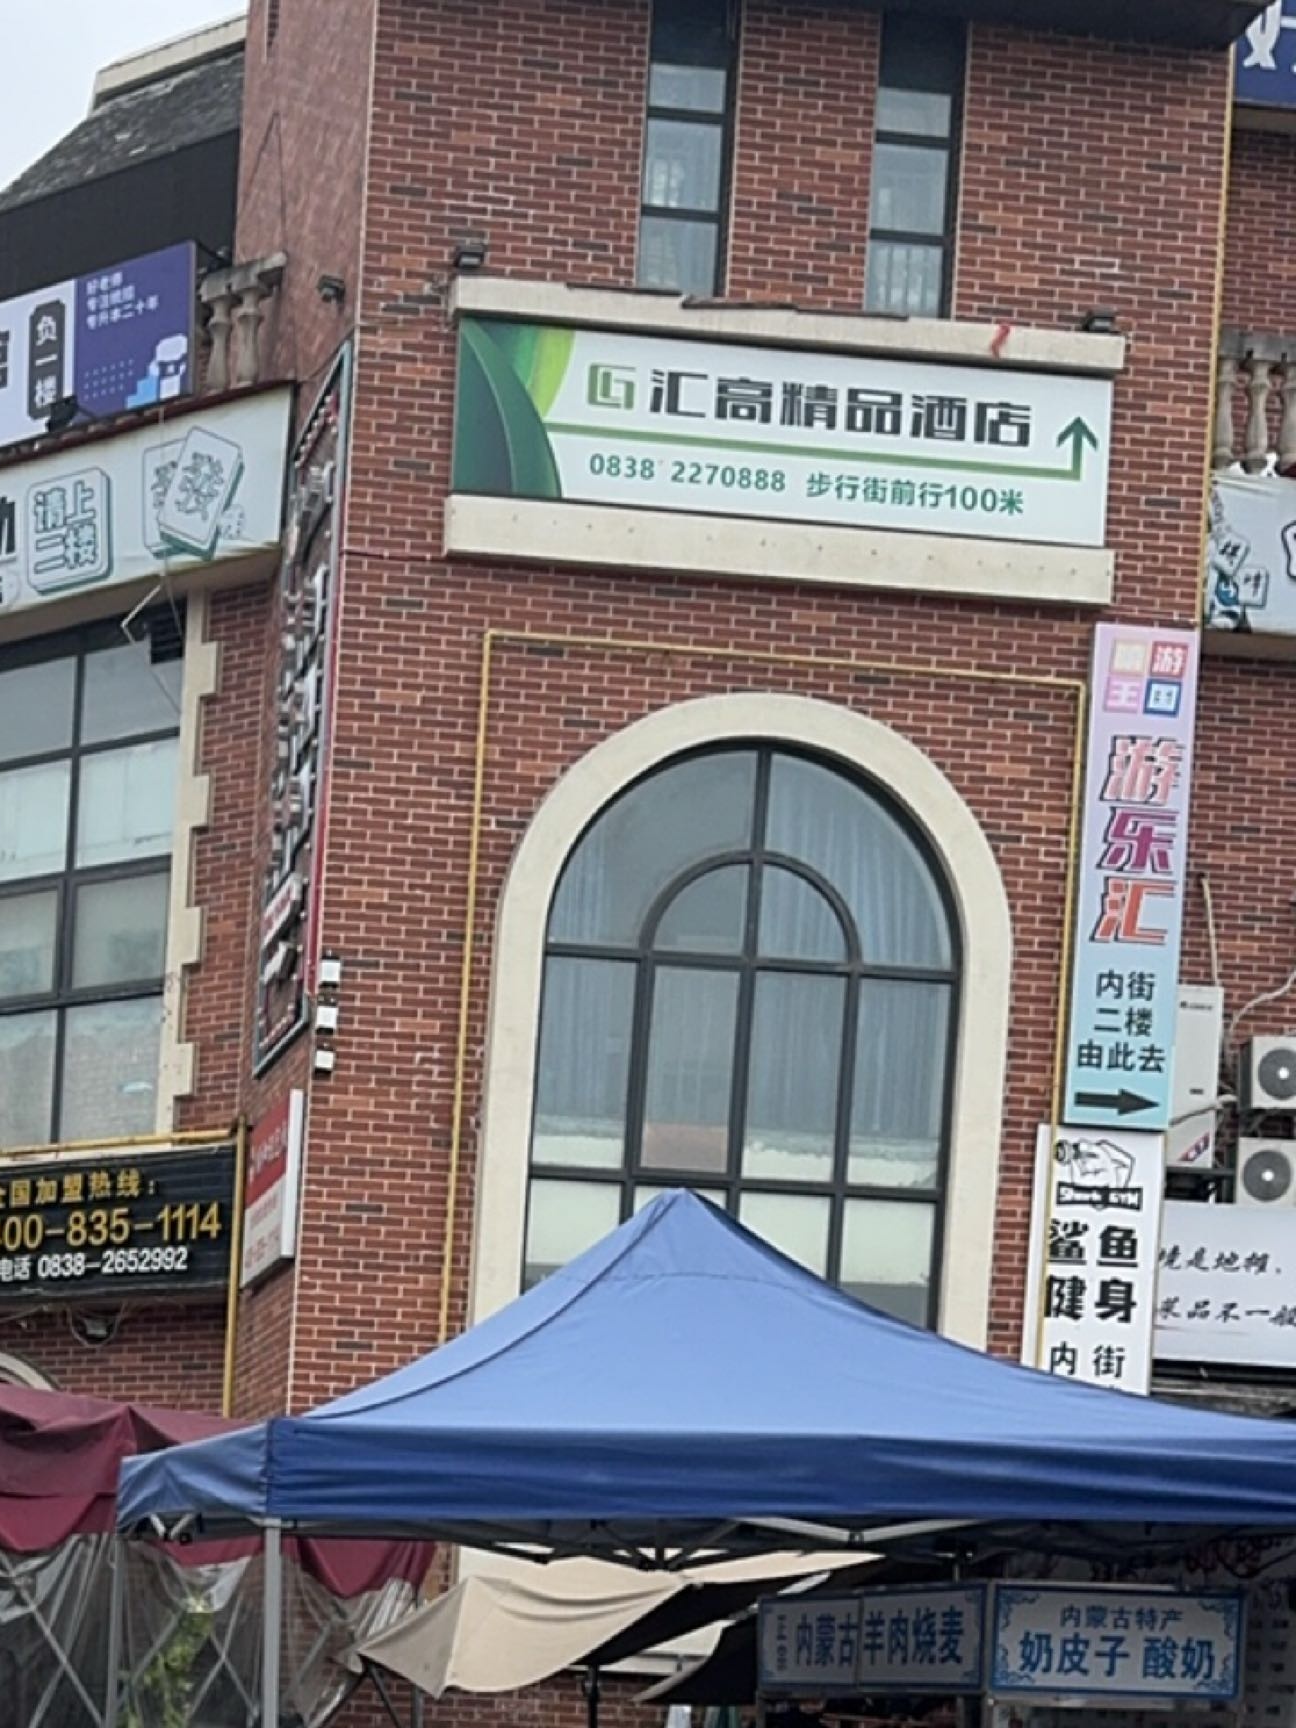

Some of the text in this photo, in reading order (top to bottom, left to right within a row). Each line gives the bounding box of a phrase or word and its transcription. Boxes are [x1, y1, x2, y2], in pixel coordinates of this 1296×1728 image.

[35, 314, 58, 409] 负一楼
[649, 367, 1032, 449] 汇高精品酒店
[34, 479, 97, 533] 请上
[589, 452, 1026, 515] 0838 2270888 步行街前行100米
[34, 521, 98, 575] 二楼
[1089, 735, 1186, 945] 游乐汇
[1096, 968, 1156, 1001] 内街
[1094, 1007, 1153, 1036] 二楼
[1077, 1039, 1165, 1073] 由此去
[37, 1246, 188, 1279] 0838-2652992
[1049, 1218, 1138, 1267] 鲨鱼
[1044, 1274, 1137, 1323] 健身
[1050, 1341, 1126, 1378] 内街
[796, 1605, 965, 1667] 内蒙古羊肉烧麦
[1059, 1603, 1184, 1632] 内蒙古特产
[1019, 1630, 1216, 1680] 奶皮子 酸奶
